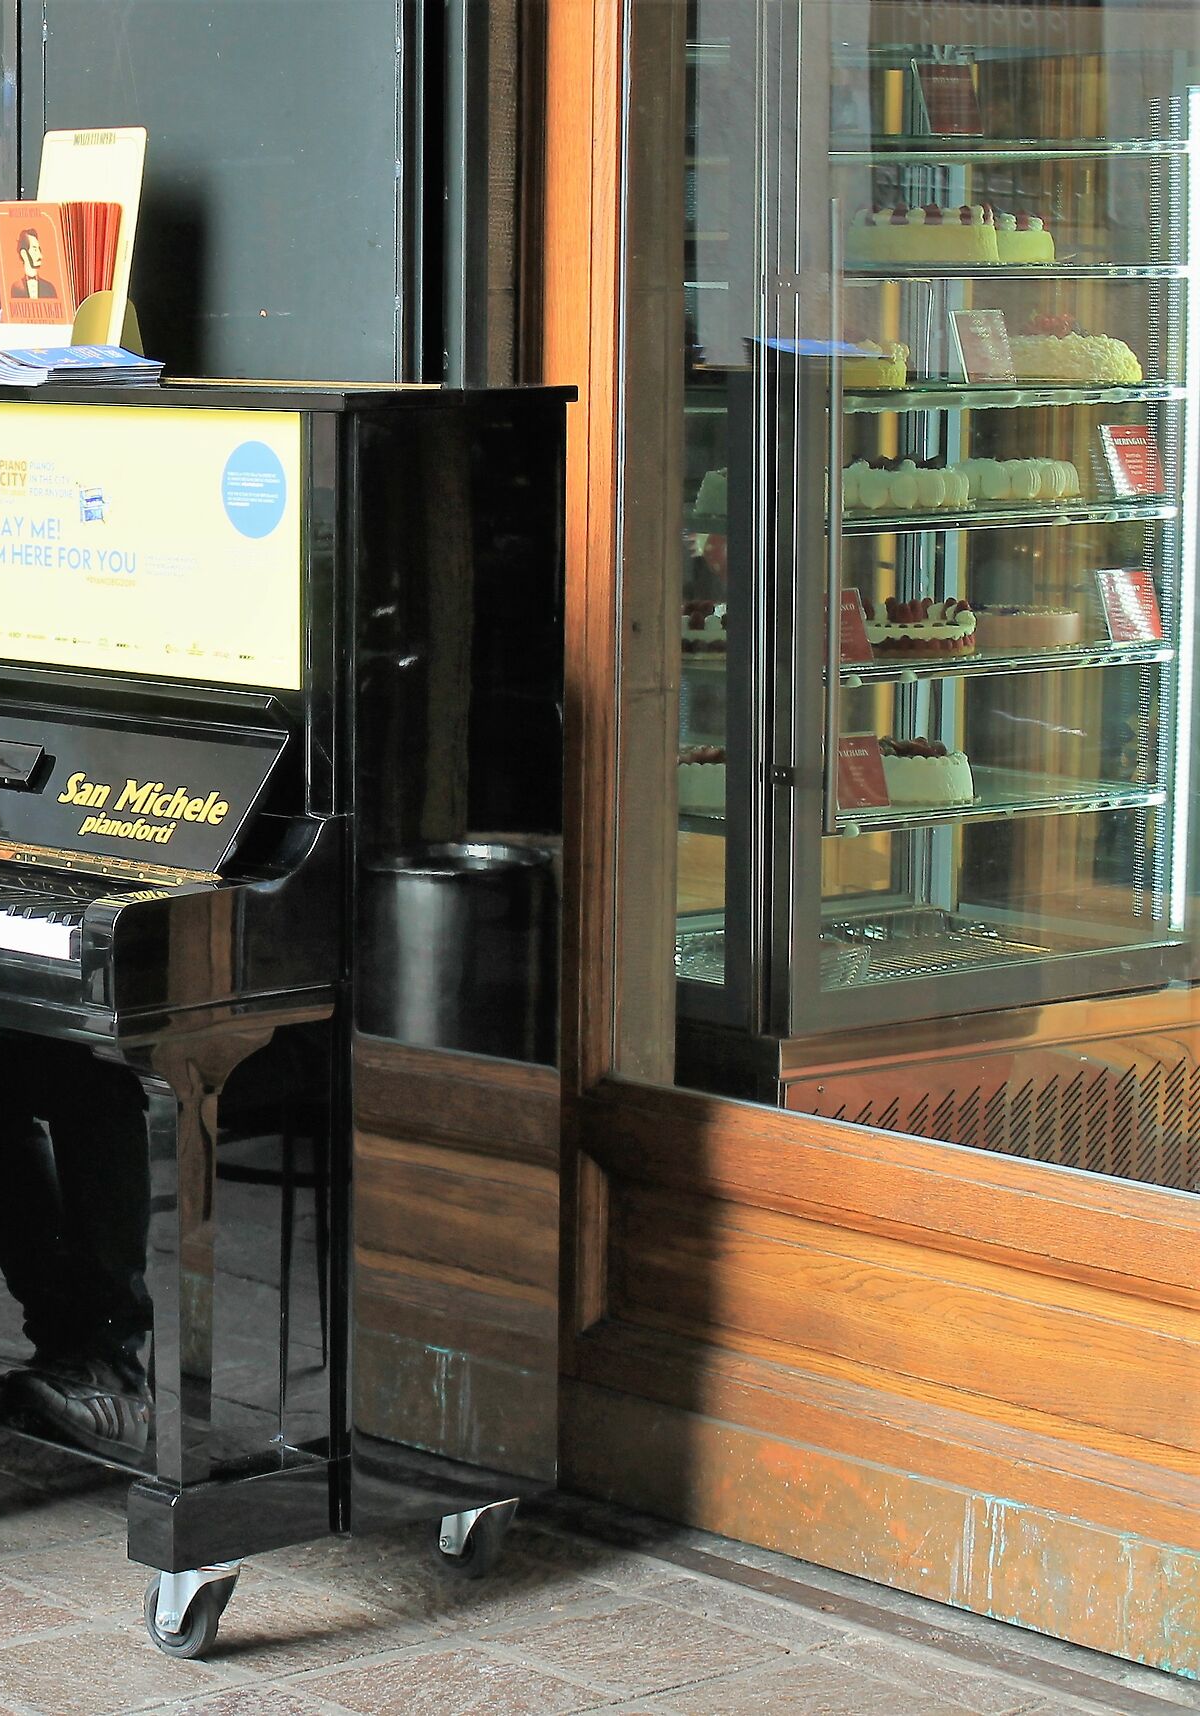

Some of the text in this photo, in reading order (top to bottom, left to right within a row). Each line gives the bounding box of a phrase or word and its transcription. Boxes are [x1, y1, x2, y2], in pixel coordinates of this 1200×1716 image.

[0, 459, 27, 472] PIANO
[0, 472, 27, 487] CITY
[31, 517, 61, 541] ME!
[11, 543, 52, 567] HERE
[58, 546, 92, 571] FOR
[97, 549, 136, 574] YOU
[57, 771, 230, 825] San Michele
[78, 811, 177, 844] pianoforti
